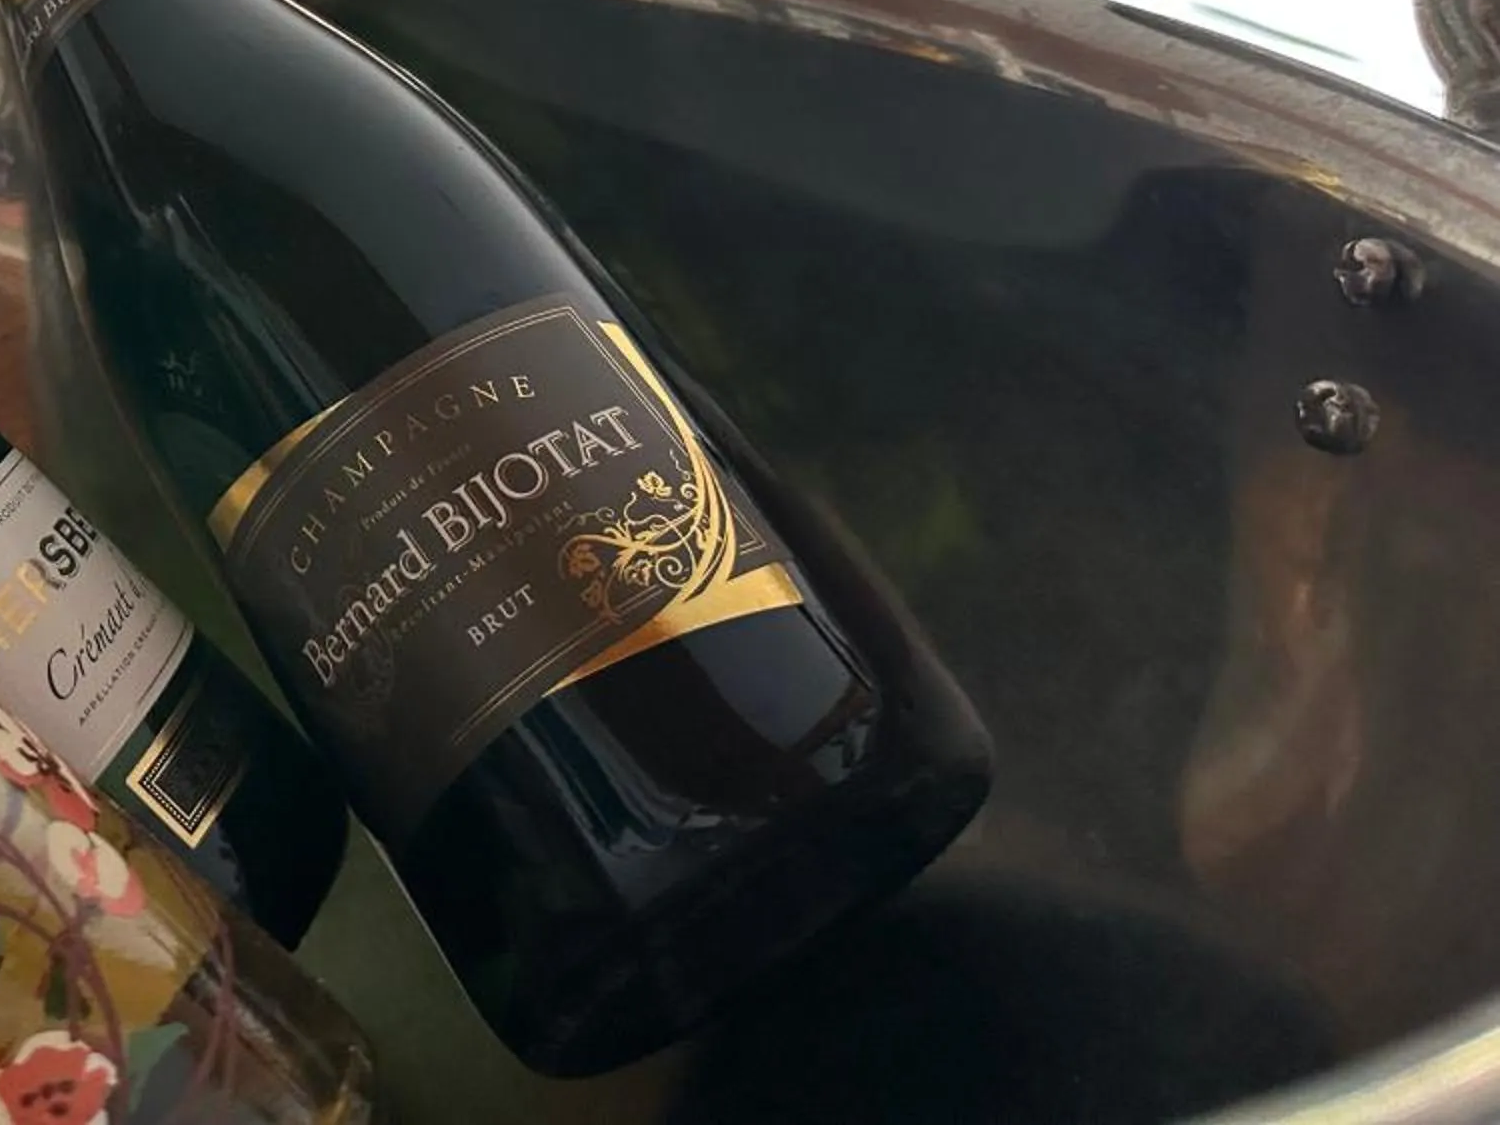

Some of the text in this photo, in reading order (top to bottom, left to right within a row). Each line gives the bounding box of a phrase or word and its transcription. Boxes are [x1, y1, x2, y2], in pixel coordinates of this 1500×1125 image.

[292, 375, 537, 575] CHAMPAGNE
[302, 405, 642, 688] Bernard BIJOTAT
[47, 579, 135, 700] Crémant
[467, 584, 536, 646] BRUT
[79, 650, 136, 727] APPELLATION
